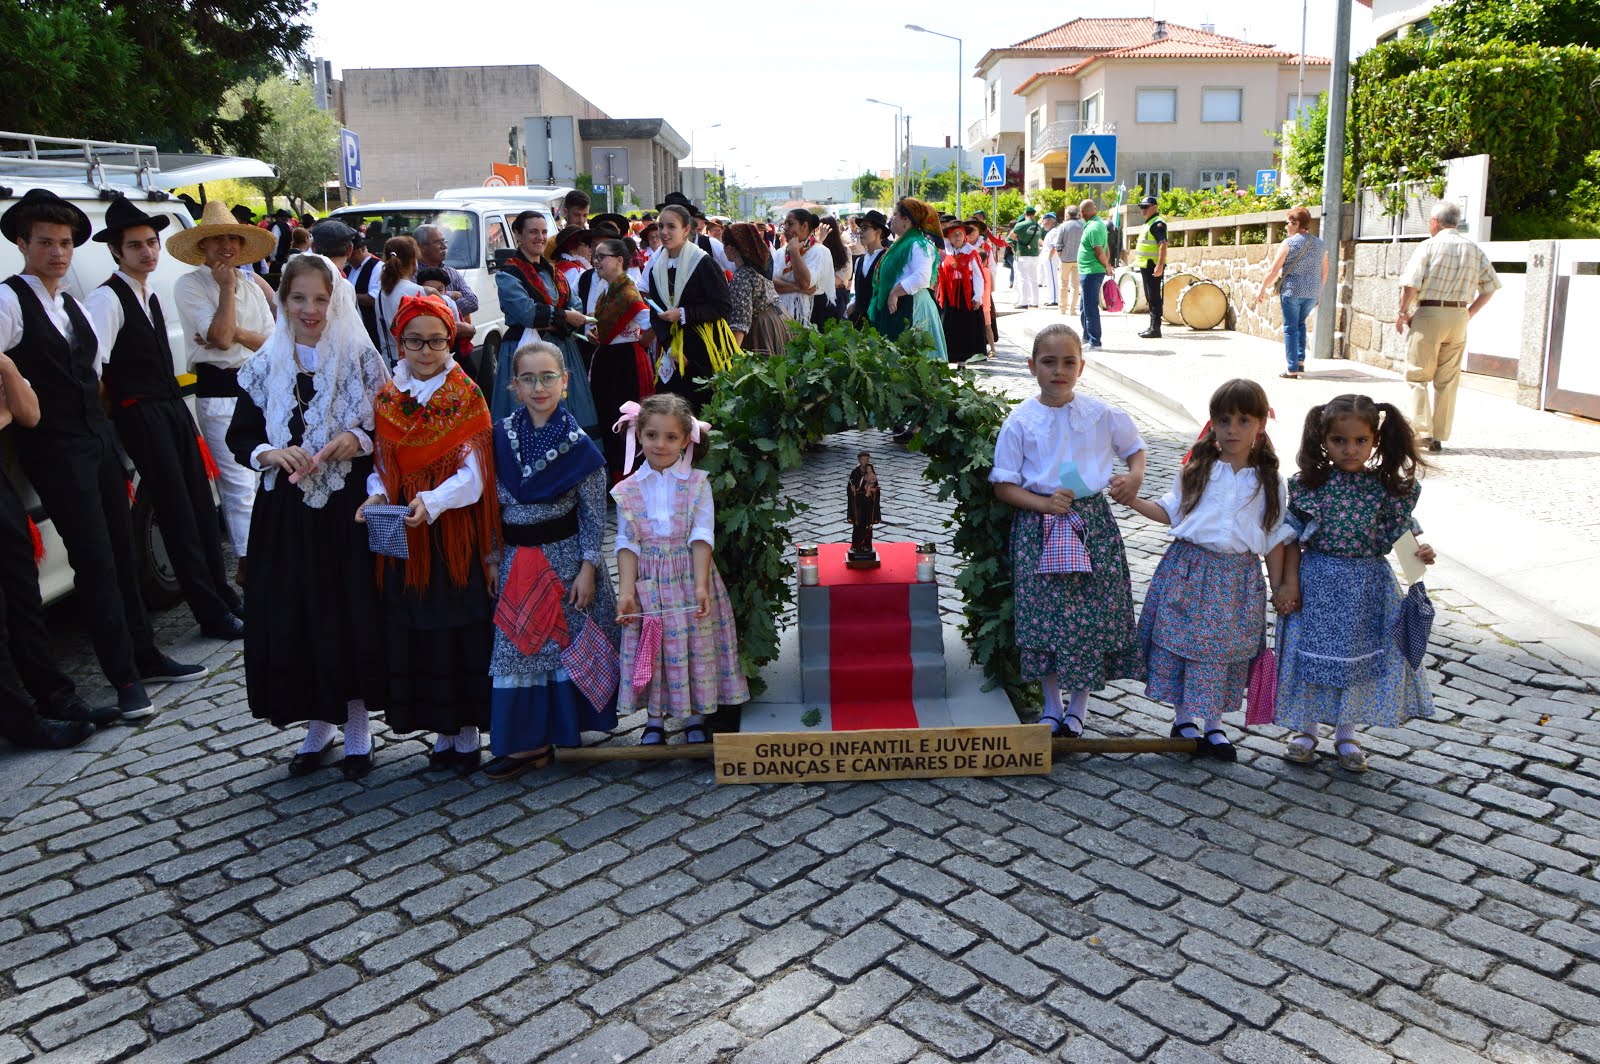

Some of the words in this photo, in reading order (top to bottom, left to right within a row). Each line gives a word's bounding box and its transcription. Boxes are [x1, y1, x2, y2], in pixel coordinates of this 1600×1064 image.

[345, 134, 358, 183] P
[755, 742, 823, 758] GRUPO
[830, 739, 914, 756] INFANTIL
[920, 738, 929, 753] E
[935, 736, 1011, 752] JUVENIL
[723, 762, 747, 776] DE
[753, 760, 830, 777] DANÇAS
[836, 759, 846, 773] E
[852, 755, 948, 773] CANTARES
[954, 754, 977, 769] DE
[982, 752, 1044, 768] JOANE
